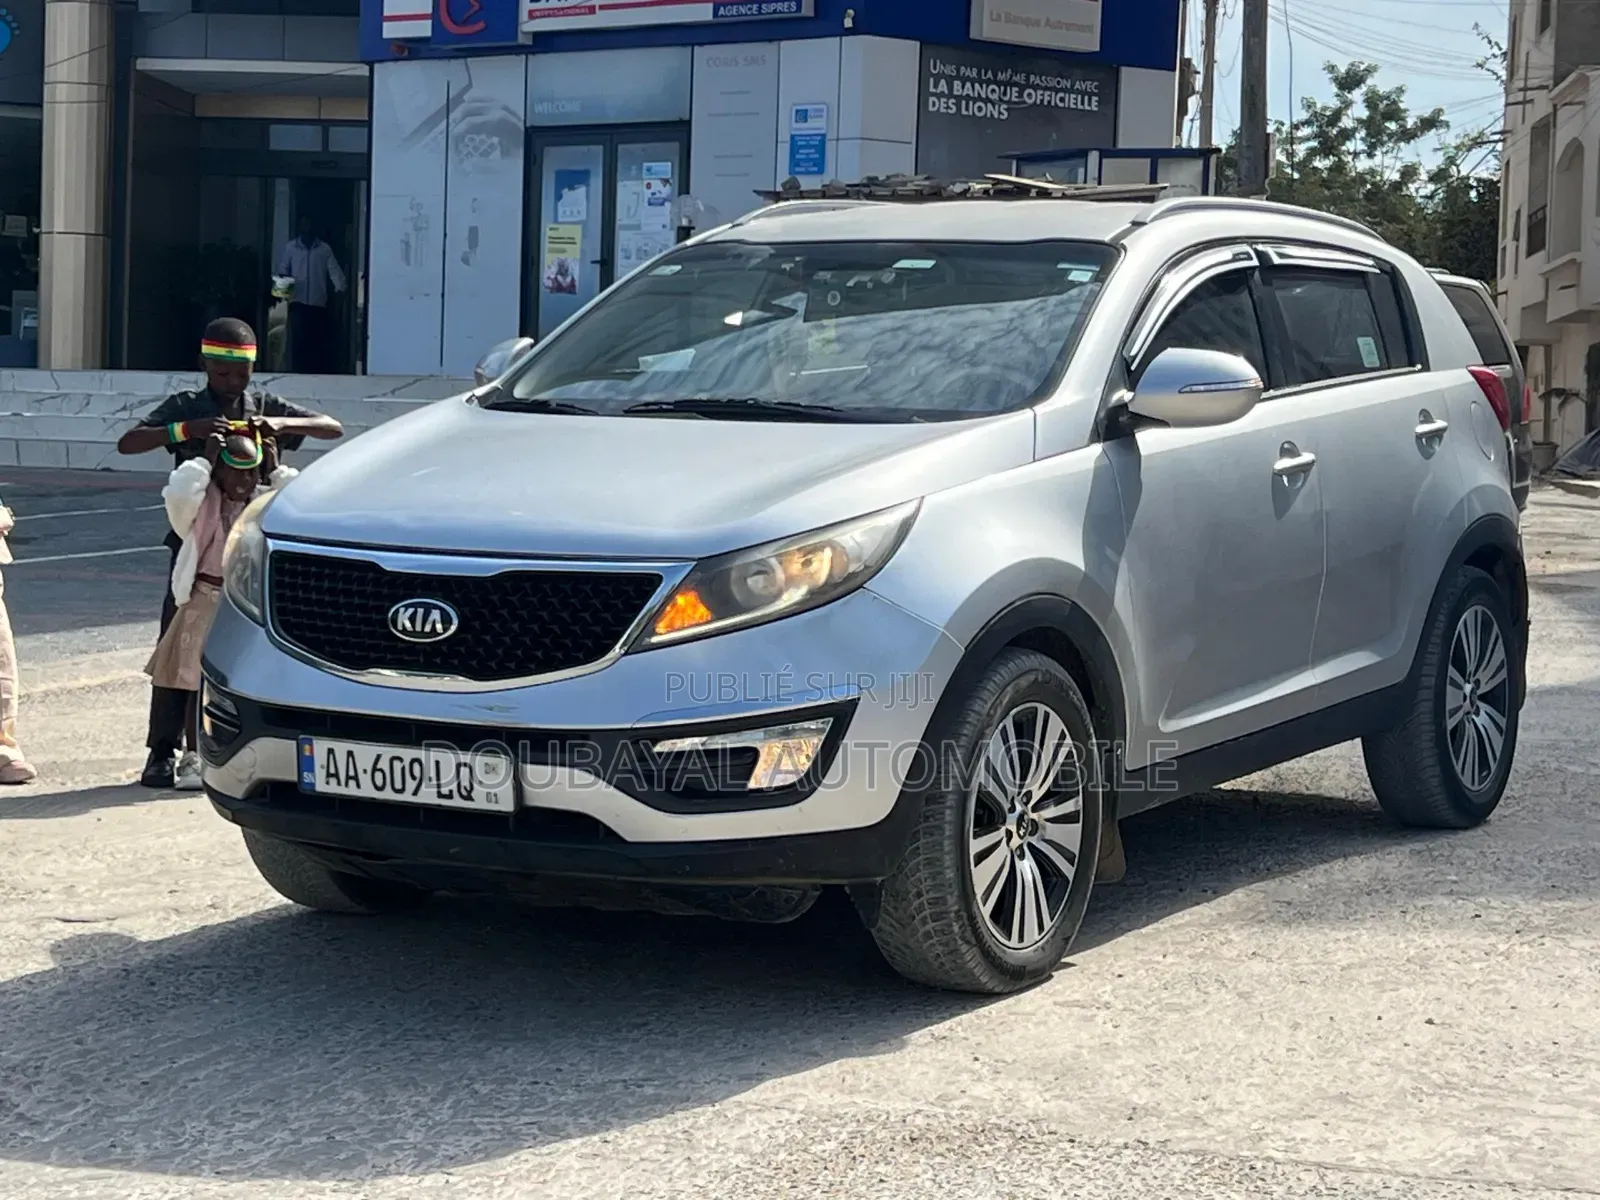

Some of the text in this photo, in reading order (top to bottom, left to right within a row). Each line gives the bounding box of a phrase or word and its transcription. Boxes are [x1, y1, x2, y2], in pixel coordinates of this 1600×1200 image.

[718, 1, 797, 16] AGENCE SIPRES
[990, 9, 1002, 22] La
[1004, 11, 1041, 29] Banque
[960, 66, 978, 79] PAR
[981, 69, 994, 80] LA
[1030, 74, 1071, 89] PASSION
[1073, 81, 1099, 93] AVEC
[929, 77, 1099, 111] LA BANQUE OFFICIELLE
[928, 97, 1009, 120] DES LIONS
